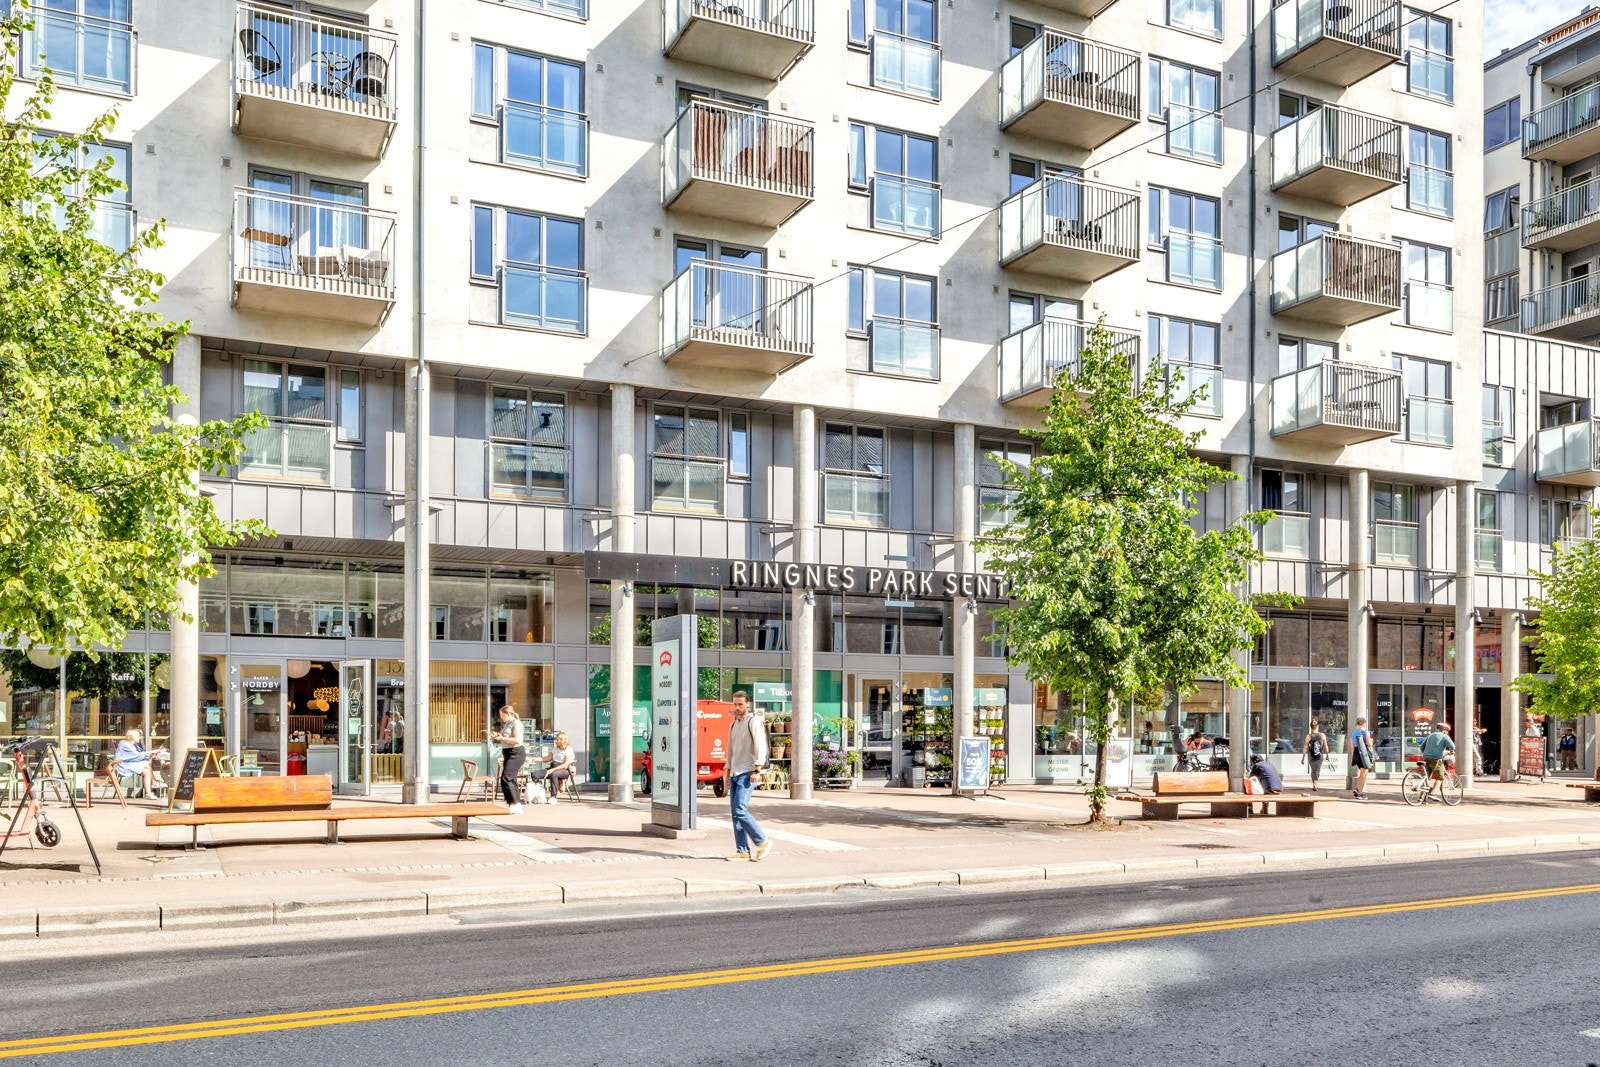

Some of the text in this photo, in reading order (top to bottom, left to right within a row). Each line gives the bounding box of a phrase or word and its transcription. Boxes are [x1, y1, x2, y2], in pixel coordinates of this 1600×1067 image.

[733, 561, 1014, 598] RINGNES PARK SENT
[111, 672, 135, 681] Kaffe
